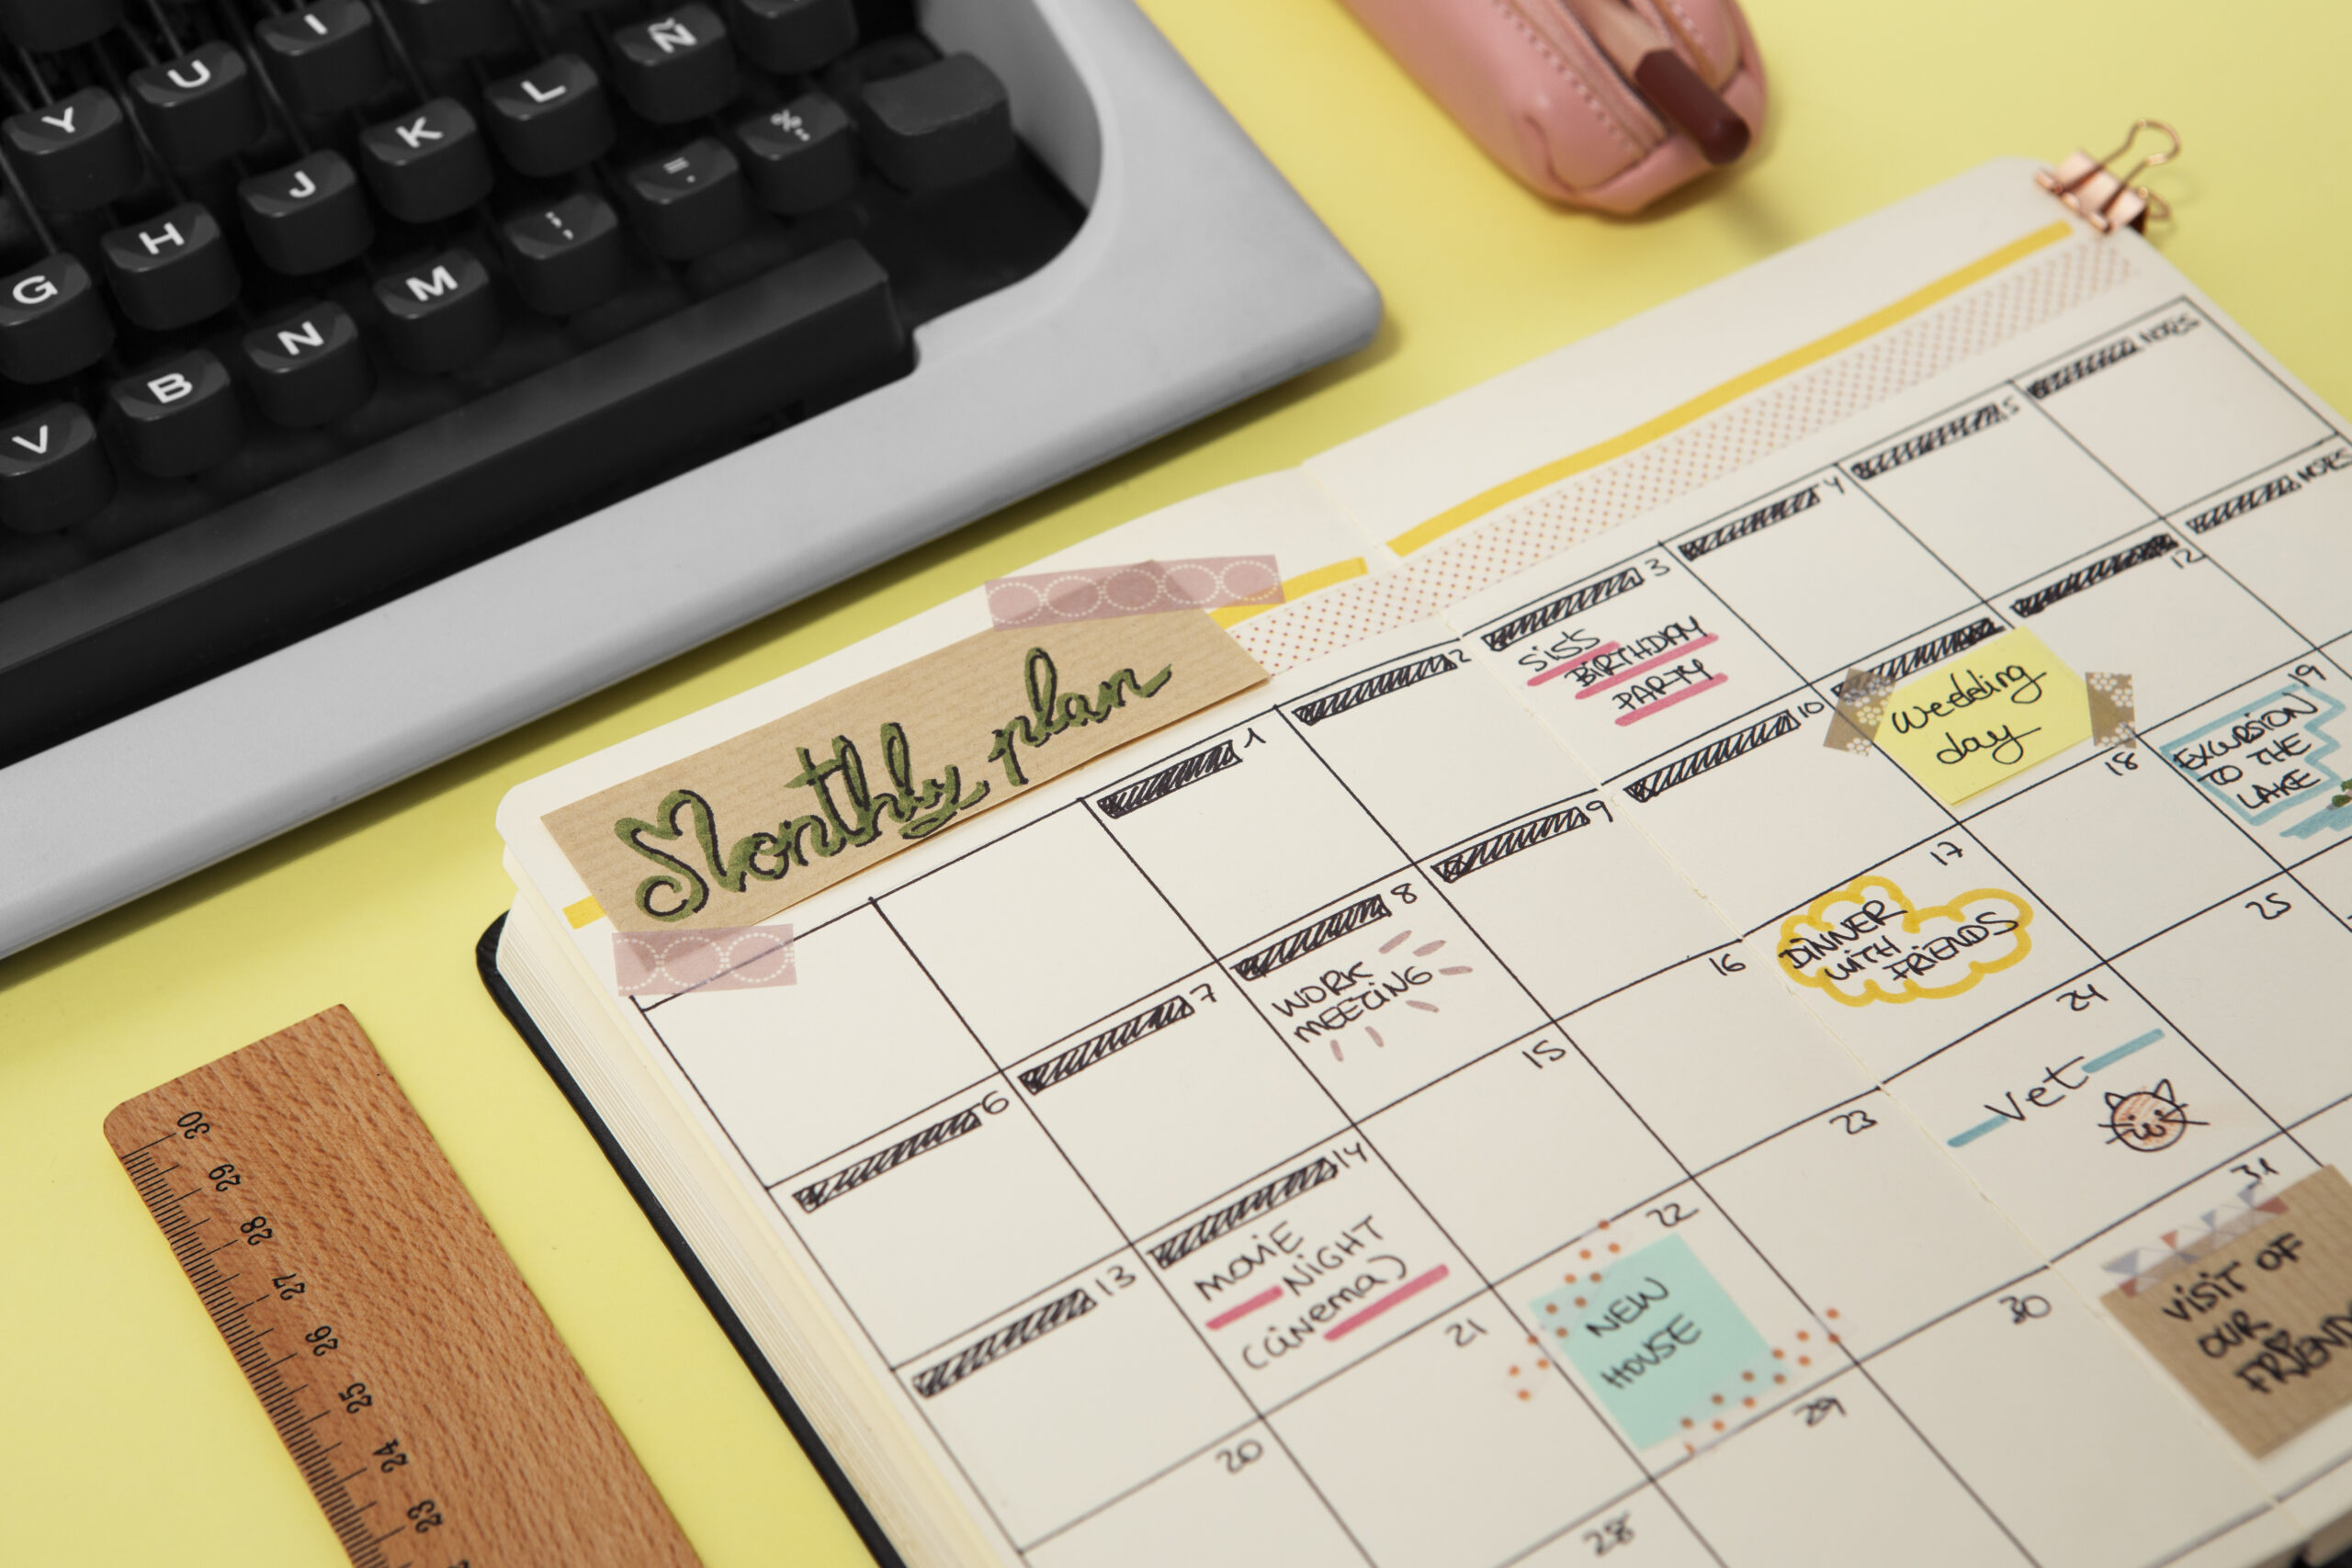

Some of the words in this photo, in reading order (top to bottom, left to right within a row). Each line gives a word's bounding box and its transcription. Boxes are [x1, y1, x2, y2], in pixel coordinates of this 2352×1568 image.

[304, 14, 328, 35] I
[648, 17, 697, 53] Ñ
[167, 60, 211, 88] U
[521, 80, 566, 103] L
[41, 106, 76, 133] Y
[395, 117, 444, 148] K
[288, 170, 317, 198] J
[139, 222, 185, 255] H
[12, 276, 58, 304] G
[405, 265, 458, 301] M
[277, 321, 324, 355] N
[147, 372, 193, 404] B
[11, 424, 49, 454] V
[1645, 558, 1670, 577] 3
[2170, 548, 2207, 570] 12
[1453, 650, 1472, 665] 2
[1611, 659, 1714, 710] PARTY
[2287, 663, 2327, 687] 19
[1798, 701, 1826, 719] 10
[1244, 728, 1267, 748] 1
[1935, 724, 2042, 765] day
[2105, 751, 2140, 775] 18
[2196, 764, 2244, 785] TO
[2245, 732, 2312, 766] THE
[615, 721, 990, 921] Monthly
[988, 647, 1172, 786] plan
[2236, 769, 2322, 809] LAKE
[1585, 799, 1614, 822] 9
[1929, 840, 1964, 865] 17
[1391, 883, 1419, 905] 8
[2245, 892, 2291, 919] 25
[1710, 953, 1747, 976] 16
[1190, 983, 1218, 1003] 7
[1272, 961, 1374, 1017] WORK
[2056, 983, 2109, 1011] 24
[1521, 1040, 1566, 1069] 15
[981, 1090, 1010, 1115] 6
[1984, 1055, 2091, 1122] Vet
[175, 1110, 210, 1140] 30
[1828, 1110, 1878, 1135] 23
[1331, 1142, 1369, 1171] 14
[2230, 1156, 2279, 1184] 31
[208, 1163, 242, 1192] 29
[1645, 1201, 1701, 1228] 22
[240, 1215, 273, 1246] 28
[2256, 1231, 2304, 1272] OF
[272, 1272, 306, 1301] 27
[1098, 1264, 1137, 1298] 13
[1585, 1277, 1671, 1338] NEW
[1997, 1293, 2052, 1325] 30
[304, 1325, 339, 1357] 26
[1445, 1317, 1489, 1348] 21
[2196, 1309, 2273, 1360] OUR
[1599, 1313, 1703, 1391] HOUSE
[337, 1381, 373, 1414] 25
[1792, 1396, 1847, 1428] 29
[372, 1438, 409, 1473] 24
[1216, 1438, 1264, 1473] 20
[406, 1498, 443, 1534] 23
[1581, 1510, 1636, 1558] 28
